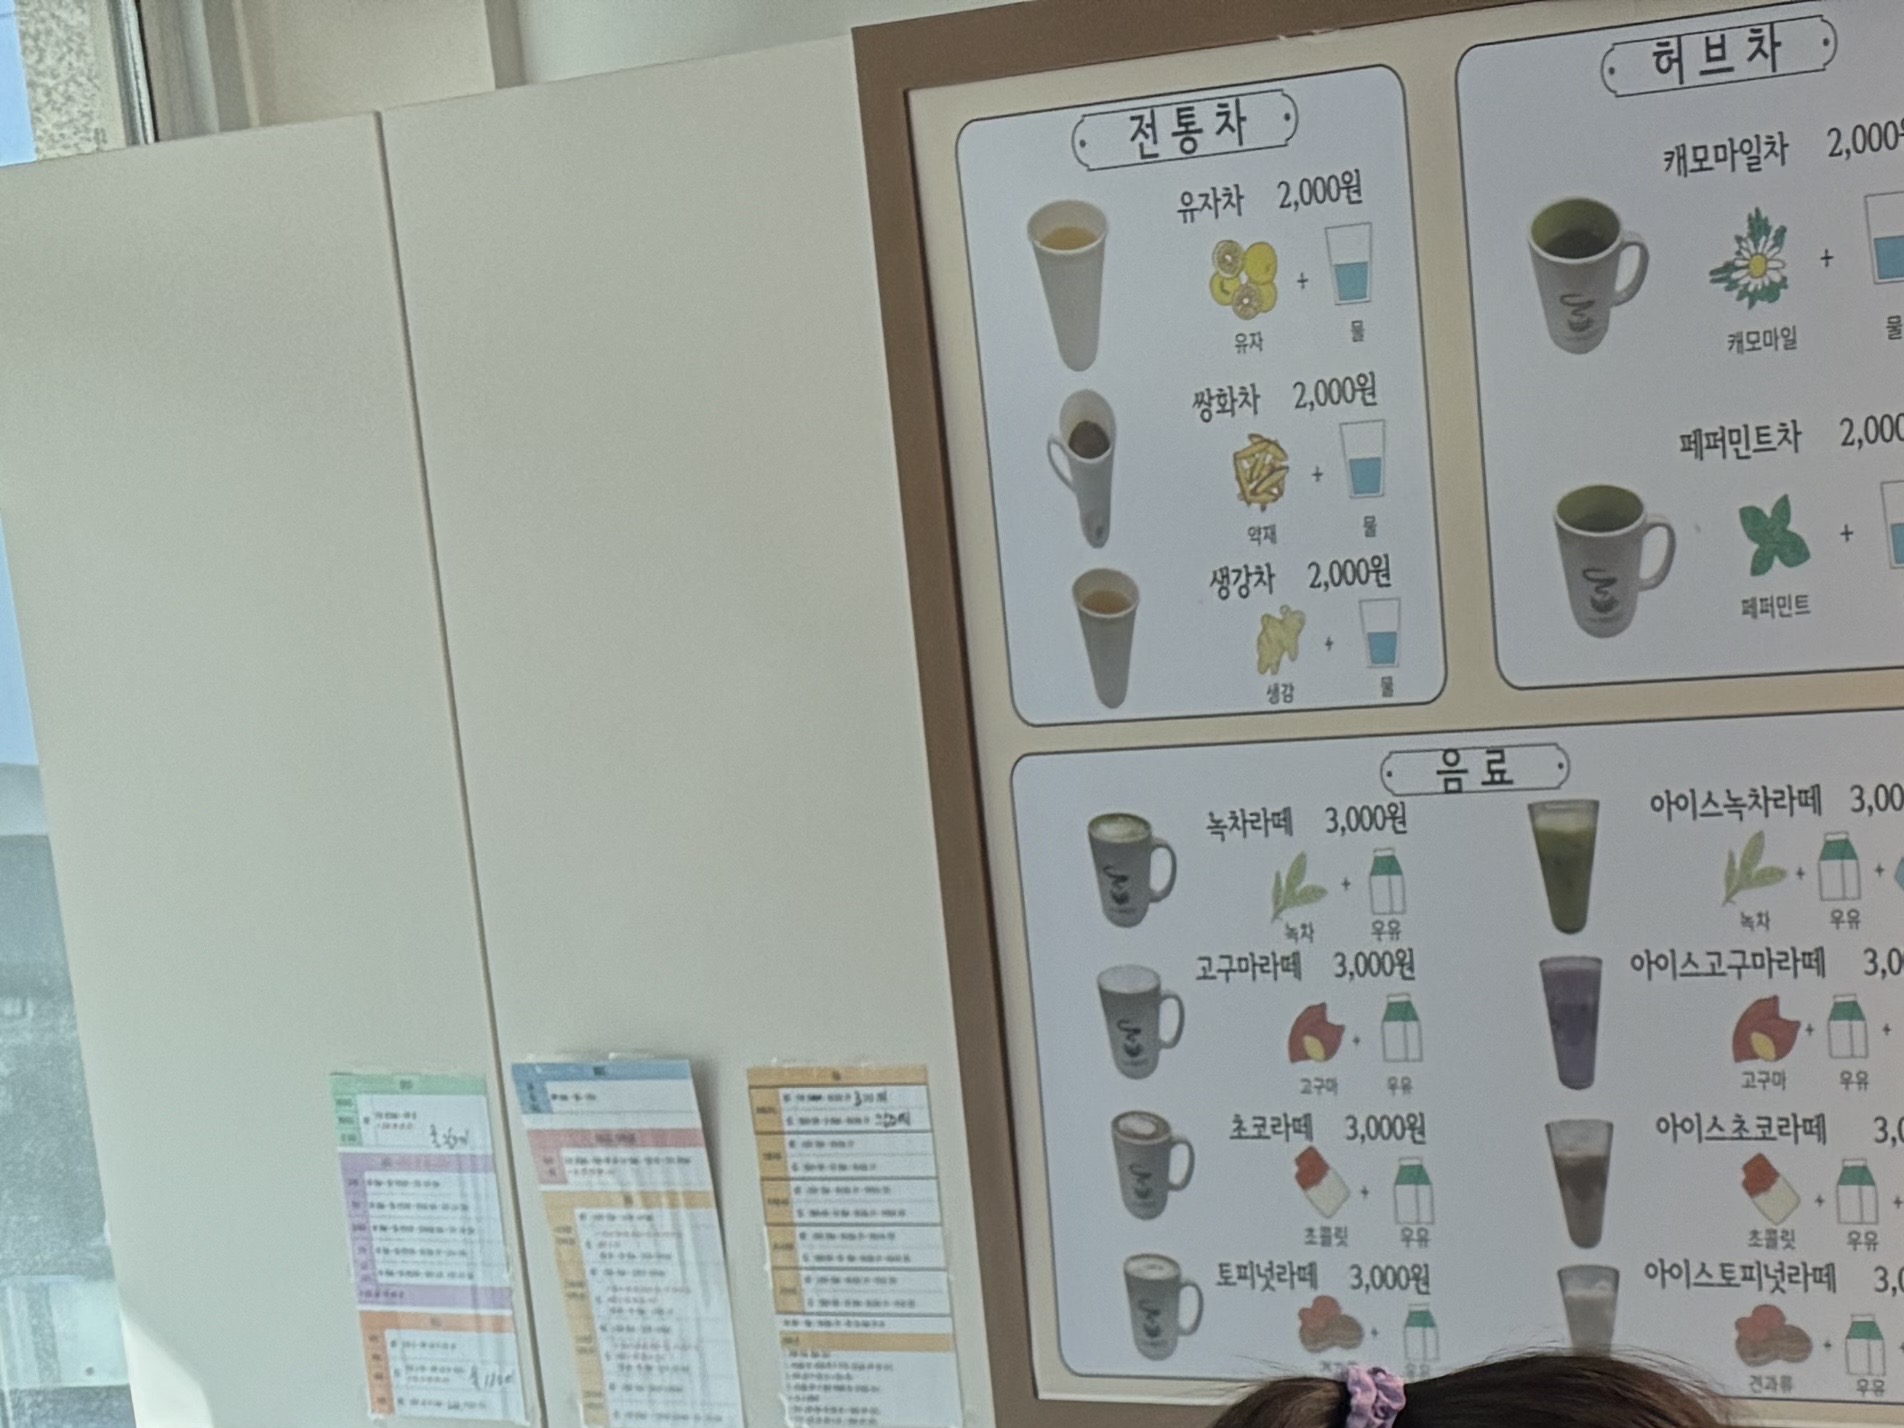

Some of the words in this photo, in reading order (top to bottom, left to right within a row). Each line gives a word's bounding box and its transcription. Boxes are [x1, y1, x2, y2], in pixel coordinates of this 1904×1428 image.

[1651, 22, 1782, 85] 허브차
[1130, 101, 1249, 158] 전통차
[1664, 131, 1789, 178] 캐모마일차
[1177, 184, 1244, 223] 유자차
[1277, 168, 1363, 211] 2,000원
[1235, 331, 1263, 354] 유자
[1728, 326, 1797, 354] 캐모마일
[1193, 383, 1261, 423] 쌍화차
[1293, 371, 1377, 411] 2,000원
[1680, 419, 1802, 461] 페퍼민트차
[1248, 524, 1277, 546] 약재
[1210, 562, 1275, 601] 생강차
[1308, 553, 1391, 592] 2,000원
[1741, 594, 1810, 619] 페퍼민트
[1437, 749, 1514, 791] 음료
[1650, 784, 1821, 822] 아이스녹차라떼
[1207, 807, 1293, 842] 녹차라떼
[1325, 801, 1407, 836] 3,000원
[1740, 911, 1770, 931] 녹차
[1831, 908, 1861, 930] 우유
[1196, 951, 1301, 983] 고구마라떼
[1334, 947, 1415, 981] 3,000원
[1630, 946, 1825, 981] 아이스고구마라떼
[1742, 1070, 1786, 1091] 고구마
[1840, 1070, 1869, 1091] 우유
[1230, 1112, 1313, 1142] 초코라떼
[1345, 1112, 1426, 1145] 3,000원
[1656, 1112, 1826, 1145] 아이스초코라떼
[1748, 1228, 1795, 1250] 초콜릿
[1216, 1260, 1318, 1292] 토피넛라떼
[1350, 1263, 1430, 1295] 3,000원
[1644, 1258, 1836, 1294] 아이스토피넛라떼
